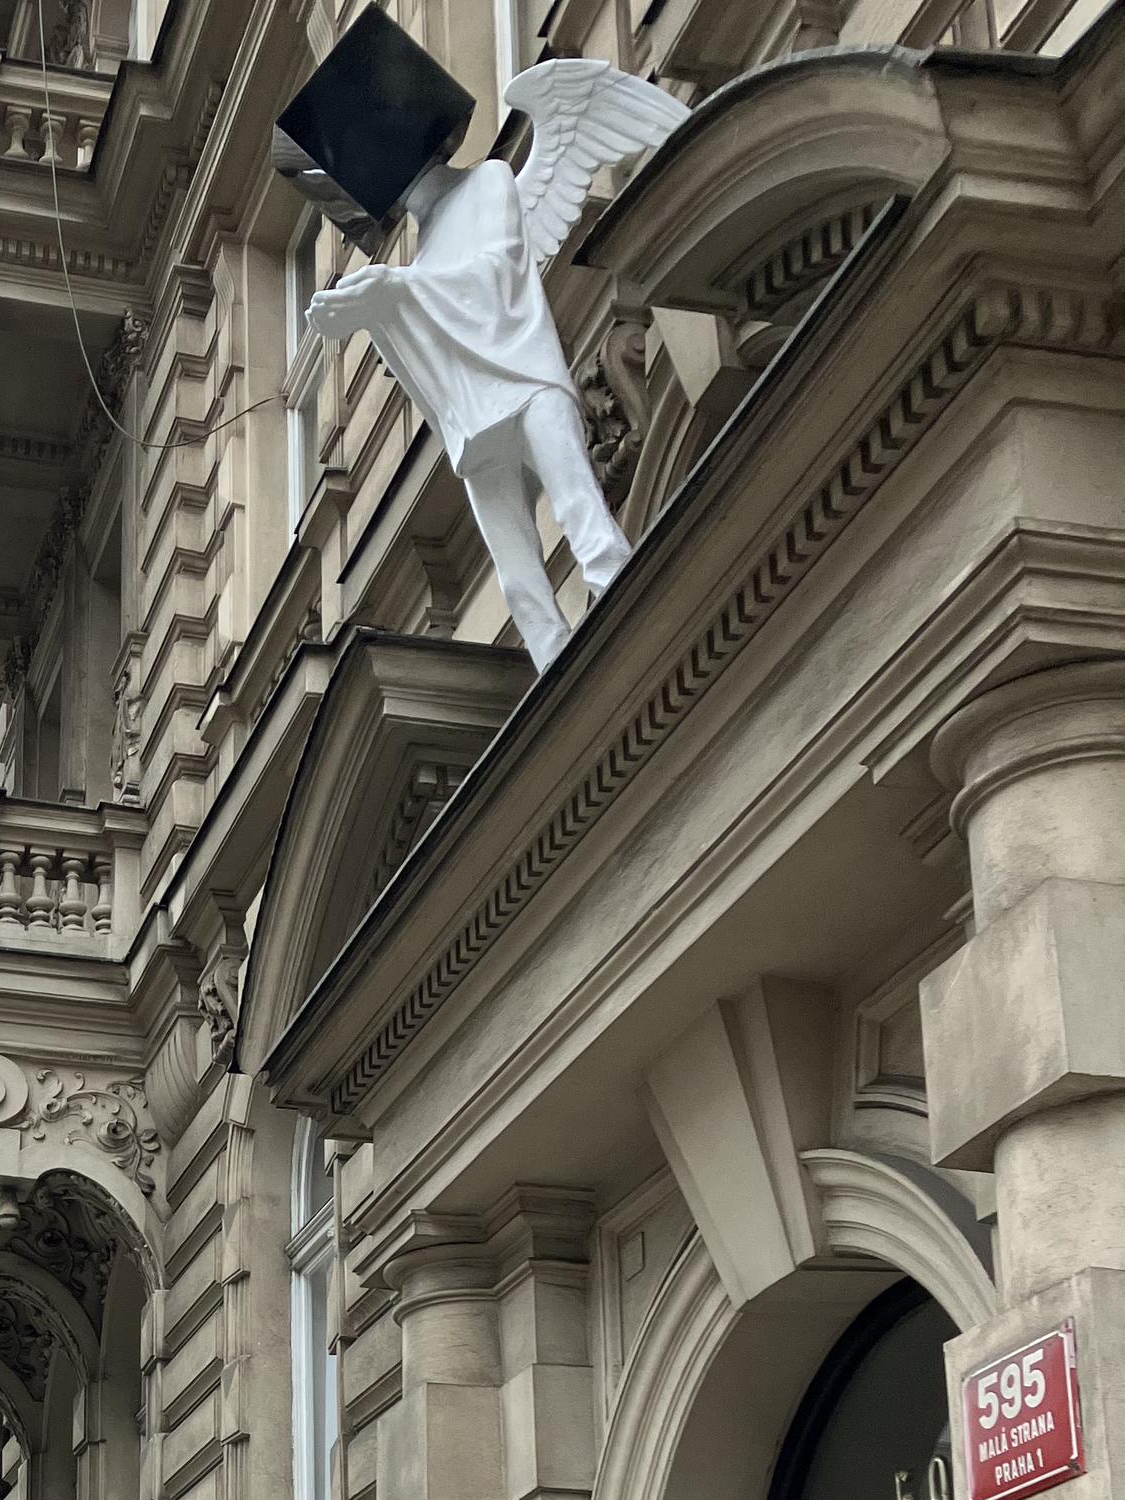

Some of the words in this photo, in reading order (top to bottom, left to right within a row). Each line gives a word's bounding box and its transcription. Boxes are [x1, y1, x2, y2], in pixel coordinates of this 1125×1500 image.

[977, 1349, 1046, 1430] 595
[978, 1427, 1009, 1463] MALÁ
[1010, 1411, 1056, 1448] STRANA
[994, 1452, 1036, 1487] PRAHA
[1036, 1448, 1045, 1469] 1
